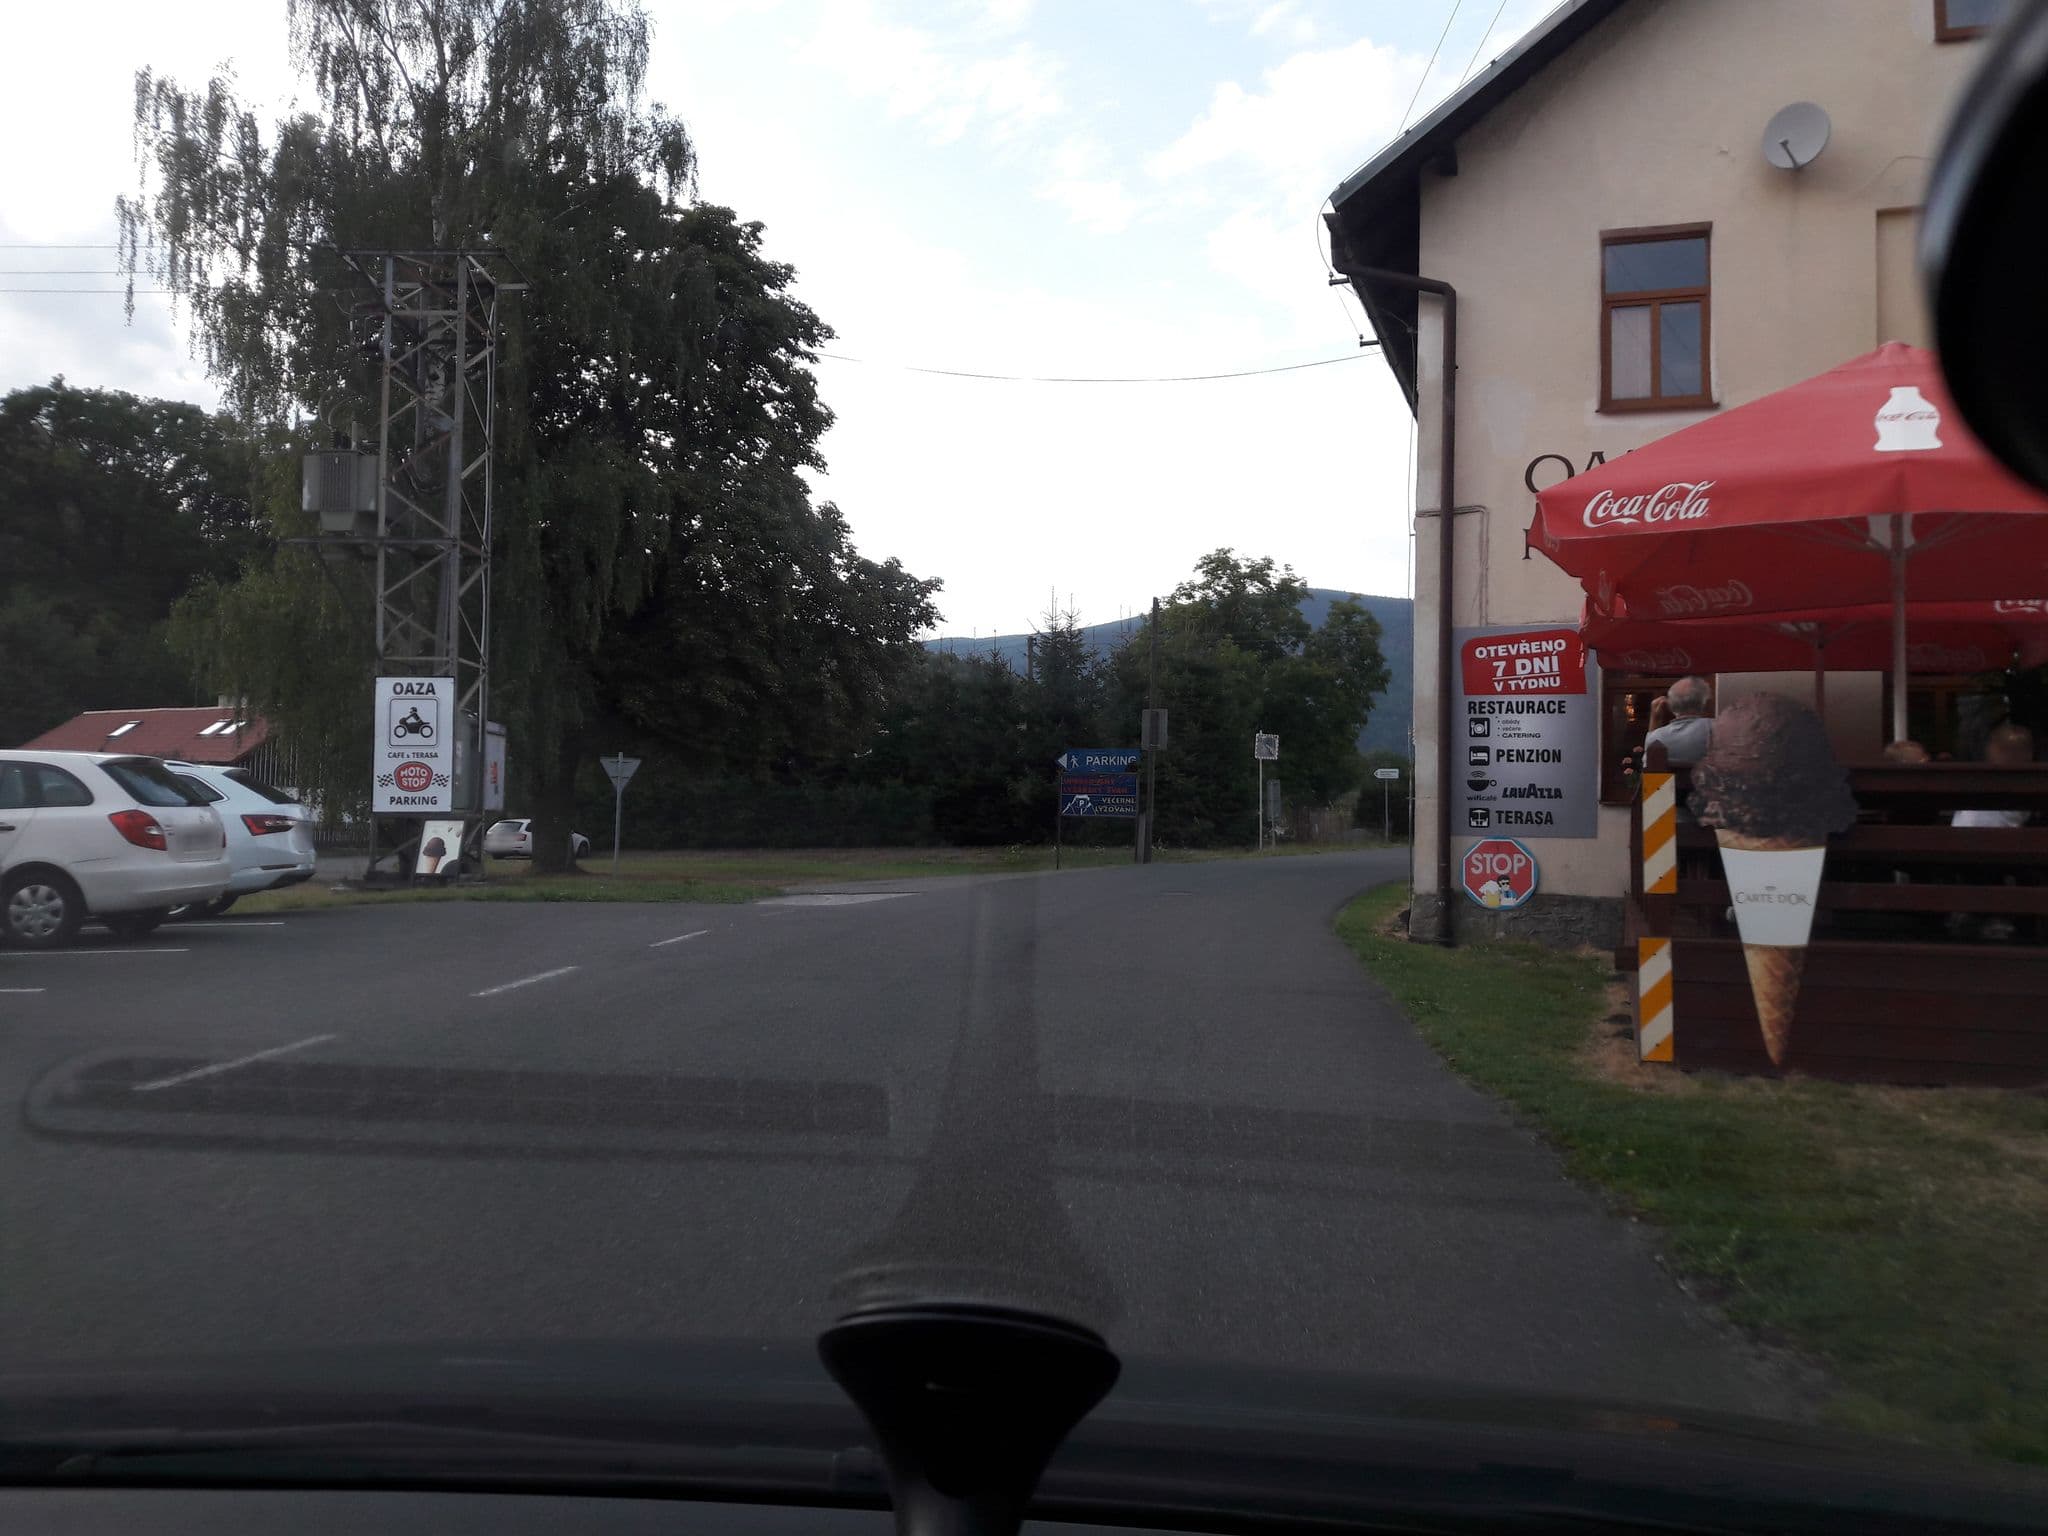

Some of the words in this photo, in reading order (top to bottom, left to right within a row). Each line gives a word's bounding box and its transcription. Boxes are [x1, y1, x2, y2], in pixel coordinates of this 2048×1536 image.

[1582, 480, 1717, 528] Coca-Cola
[1475, 639, 1566, 659] OTEVŘENO
[1492, 660, 1506, 677] 7
[1515, 650, 1559, 676] DNÍ
[392, 682, 436, 695] OAZA
[1493, 681, 1504, 692] V
[1508, 676, 1560, 691] TÝDNU
[1467, 700, 1567, 714] RESTAURACE
[1086, 755, 1137, 766] PARKING
[1496, 749, 1561, 763] PENZION
[400, 766, 428, 777] MOTO
[402, 777, 426, 788] STOP
[389, 796, 438, 806] PARKING
[1495, 810, 1554, 825] TERASA
[1470, 853, 1526, 875] STOP
[1735, 891, 1774, 904] CARTE
